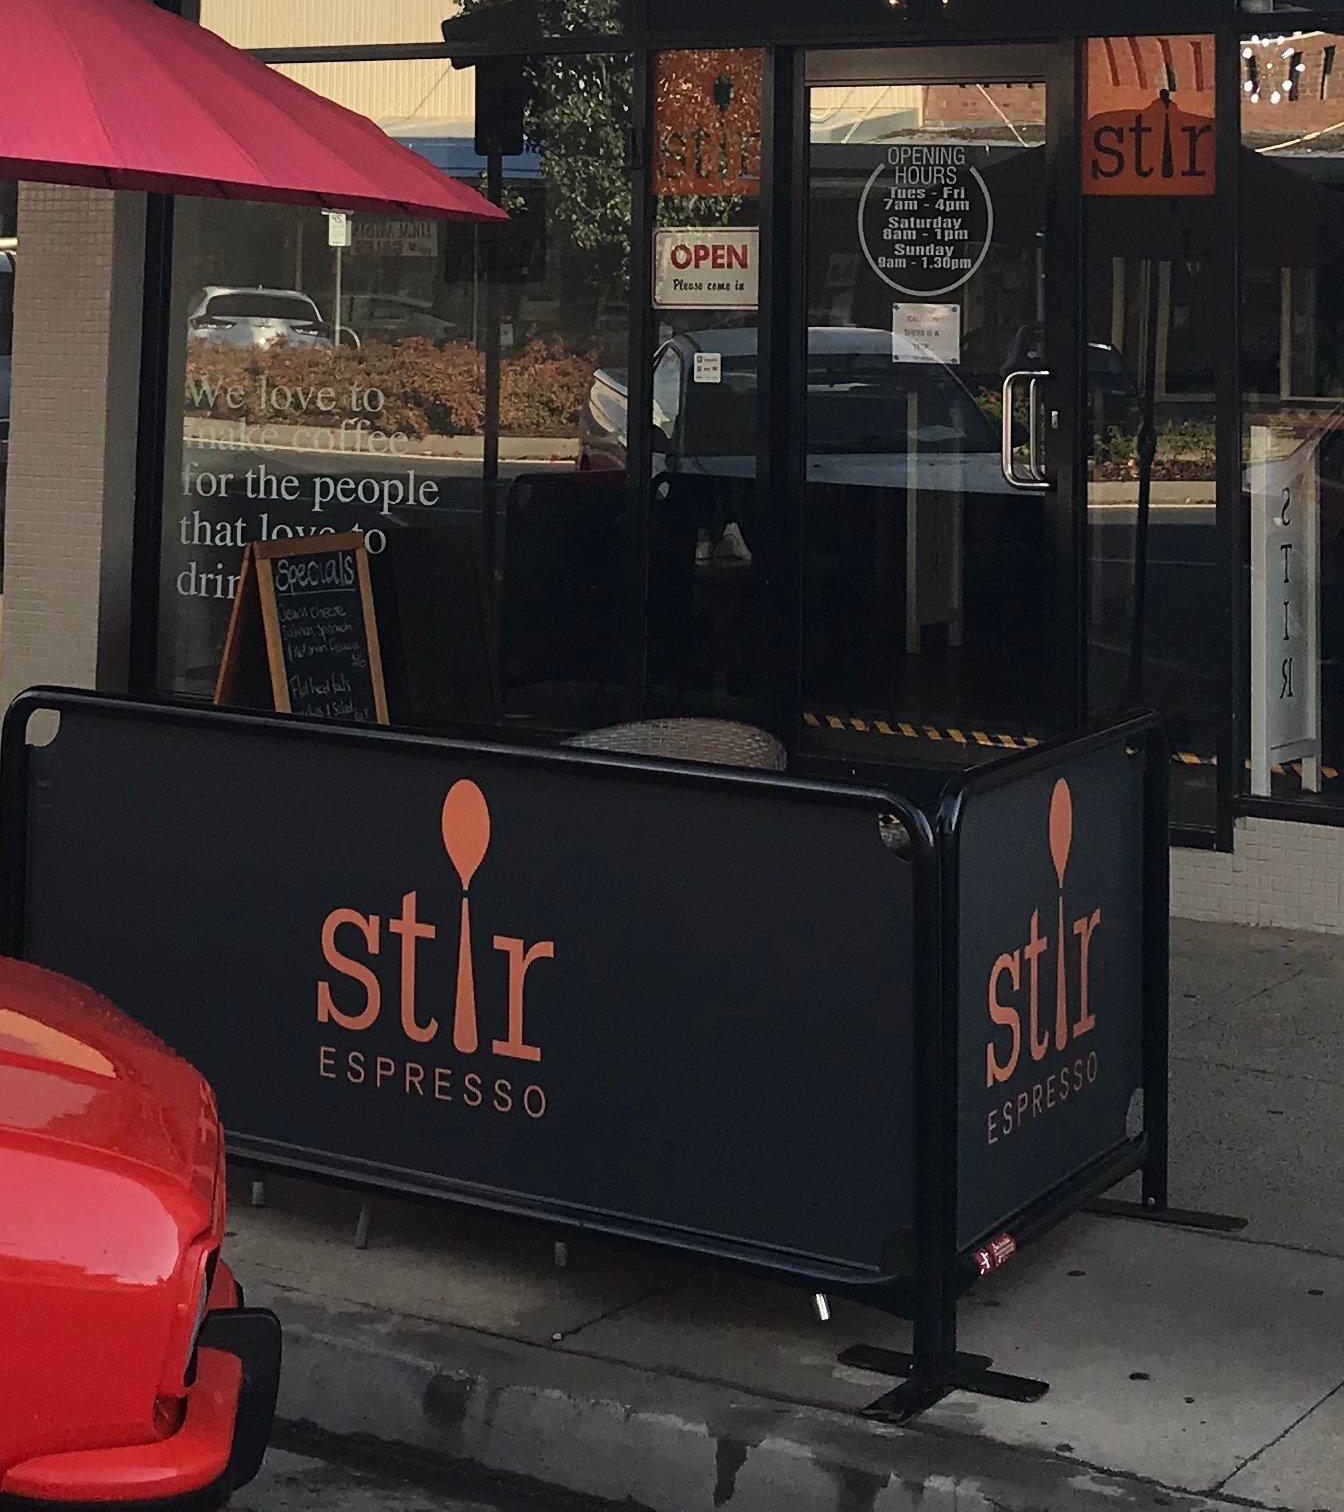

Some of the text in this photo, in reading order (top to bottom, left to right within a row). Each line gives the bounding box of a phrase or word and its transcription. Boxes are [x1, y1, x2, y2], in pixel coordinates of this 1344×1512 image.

[1091, 88, 1213, 180] stir
[887, 146, 965, 165] OPENING
[895, 166, 957, 185] HOURS
[883, 198, 918, 210] 7am
[934, 198, 970, 212] 4pm
[888, 186, 926, 199] Tues
[942, 186, 965, 199] Fri
[882, 228, 917, 240] 8am
[934, 228, 968, 241] 1pm
[888, 216, 962, 230] Saturday
[670, 243, 748, 270] OPEN
[878, 256, 907, 268] 9am
[921, 256, 972, 270] 1.30pm
[894, 243, 955, 257] Sunday
[673, 278, 745, 291] Please come in
[187, 375, 385, 413] We love to
[291, 418, 409, 455] coffee
[180, 462, 440, 516] for the people
[179, 510, 247, 547] that
[317, 778, 554, 1062] stir
[986, 778, 1101, 1088] stir
[319, 1045, 547, 1119] ESPRESSO
[987, 1050, 1098, 1146] ESPRESSO
